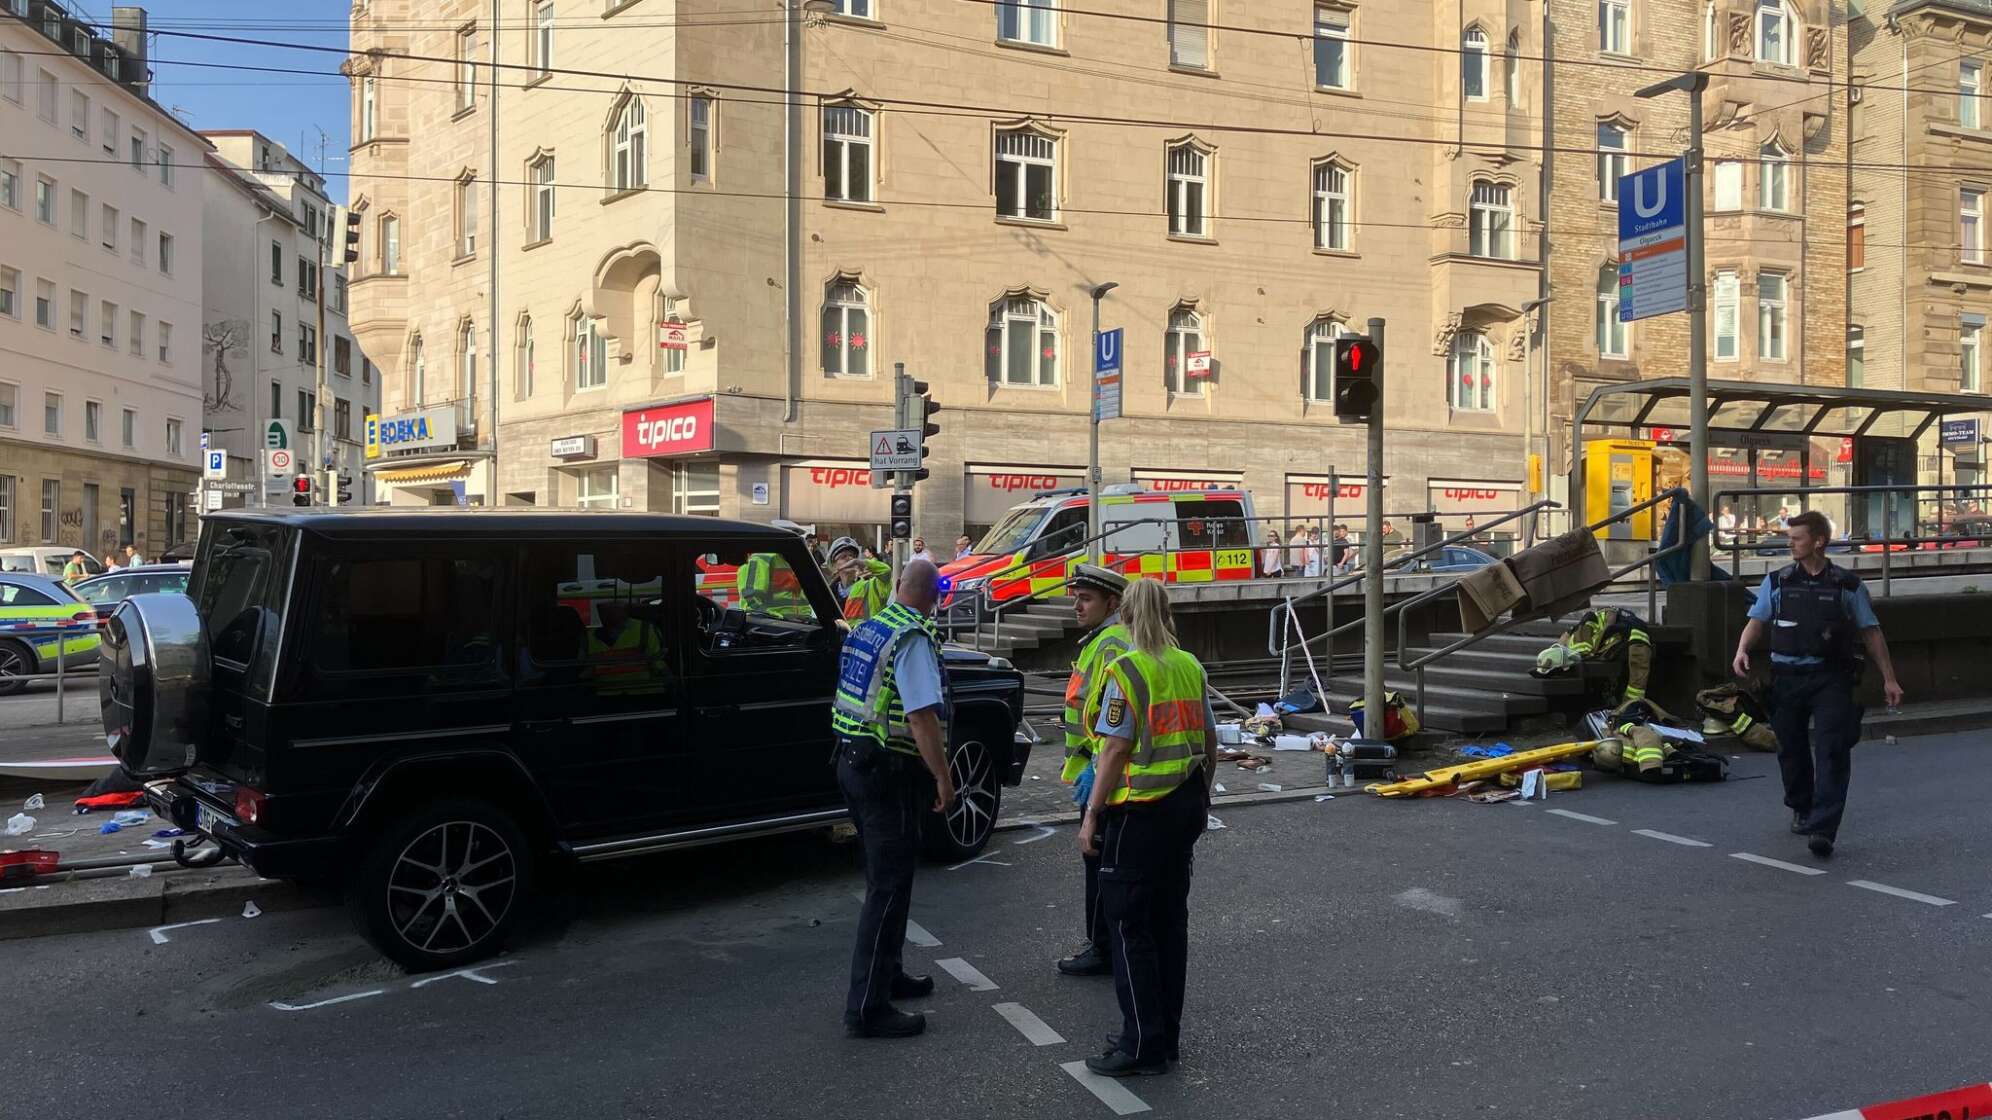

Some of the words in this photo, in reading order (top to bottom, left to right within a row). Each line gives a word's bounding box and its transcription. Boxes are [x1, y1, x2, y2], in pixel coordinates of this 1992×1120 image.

[1634, 167, 1667, 218] U
[1102, 332, 1114, 361] U
[380, 417, 429, 443] EDEKA
[637, 413, 697, 449] tipico
[212, 455, 219, 468] P
[874, 456, 887, 464] hat
[888, 455, 918, 466] Vorrang
[210, 482, 256, 490] Charlottenstr.
[810, 467, 874, 488] tipic
[990, 474, 1057, 491] tipico
[1304, 483, 1361, 500] tipco
[1226, 552, 1247, 566] 112
